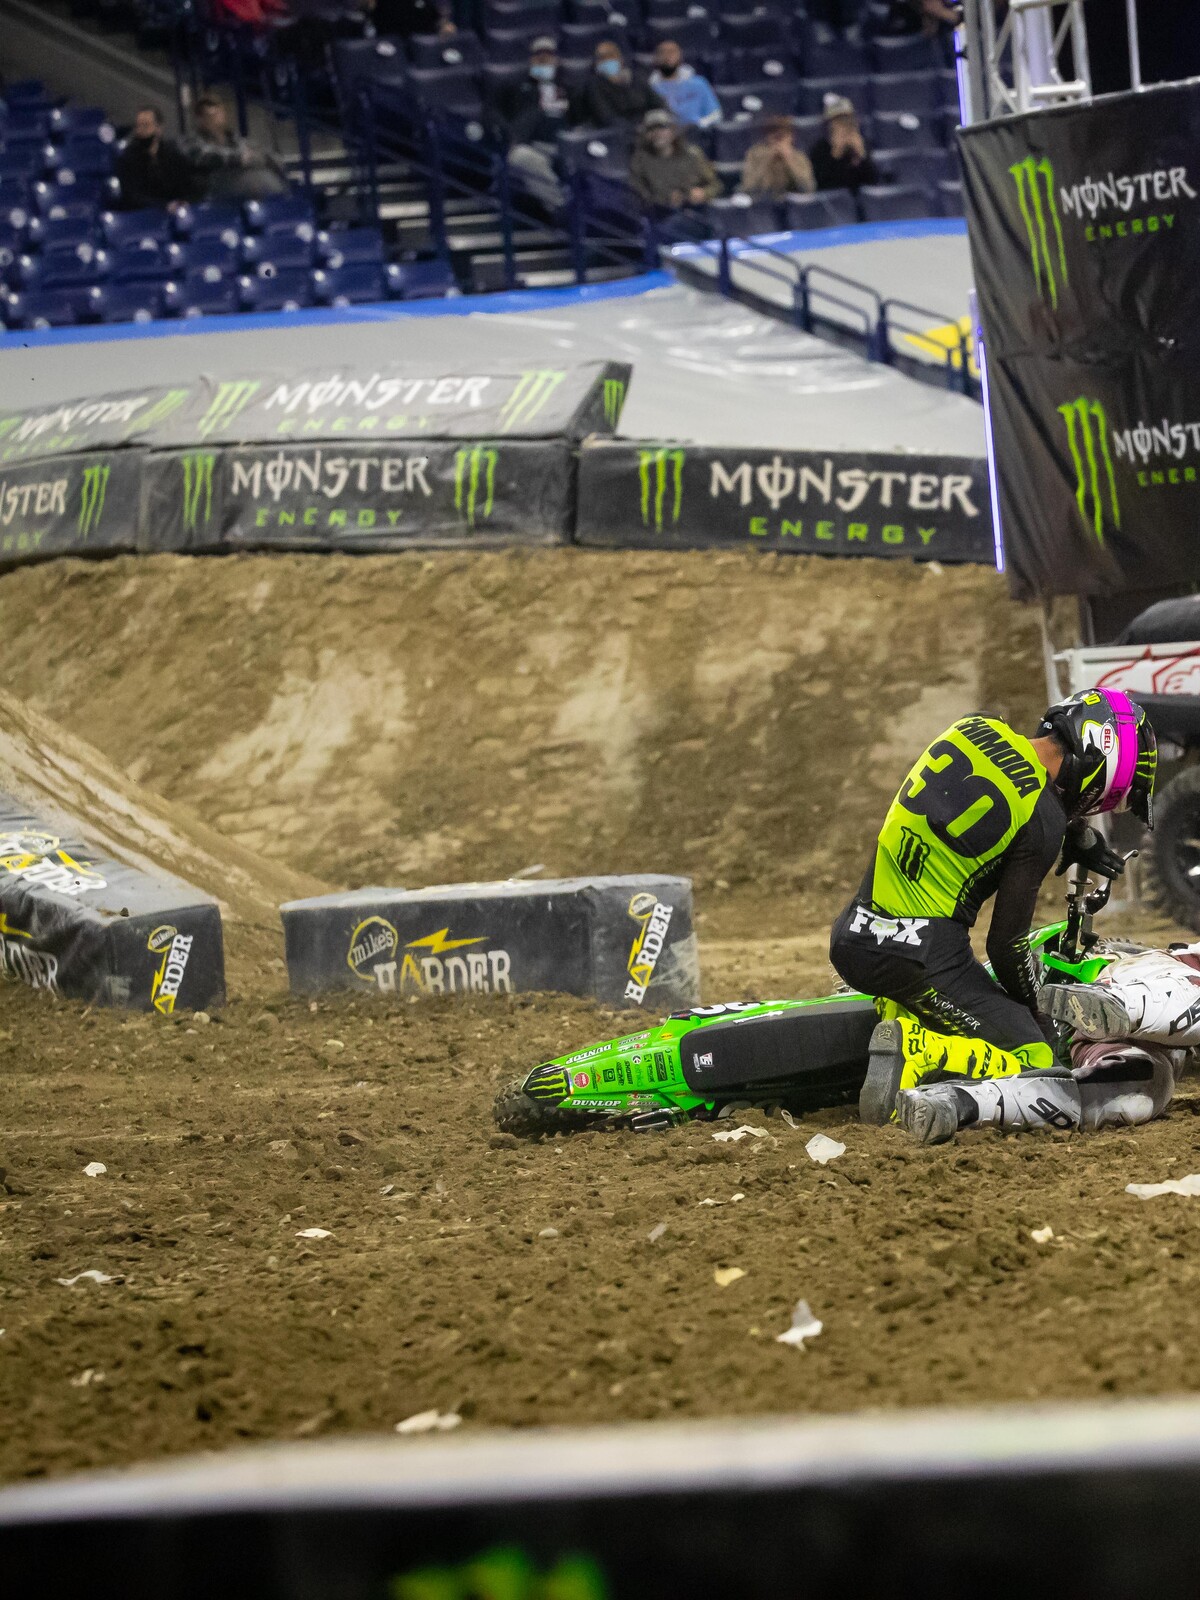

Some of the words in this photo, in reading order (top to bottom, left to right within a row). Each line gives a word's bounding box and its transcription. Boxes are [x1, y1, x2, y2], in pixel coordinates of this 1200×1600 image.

[1060, 166, 1197, 219] MONSTER
[1084, 213, 1177, 242] ENERGY
[265, 372, 492, 412] MONSTER
[231, 450, 432, 501] MONSTER
[710, 456, 979, 519] MONSTER
[255, 506, 403, 529] ENERGY
[749, 516, 938, 545] ENERGY
[953, 716, 1043, 798] SHIMODA
[1103, 728, 1111, 750] BELL
[898, 739, 1012, 858] 30
[849, 905, 930, 946] FOX
[352, 927, 395, 966] mike's
[624, 902, 673, 1004] HARDER
[373, 949, 512, 994] HARDER
[565, 1043, 613, 1064] DUNLOP
[571, 1099, 621, 1107] DUNLOP
